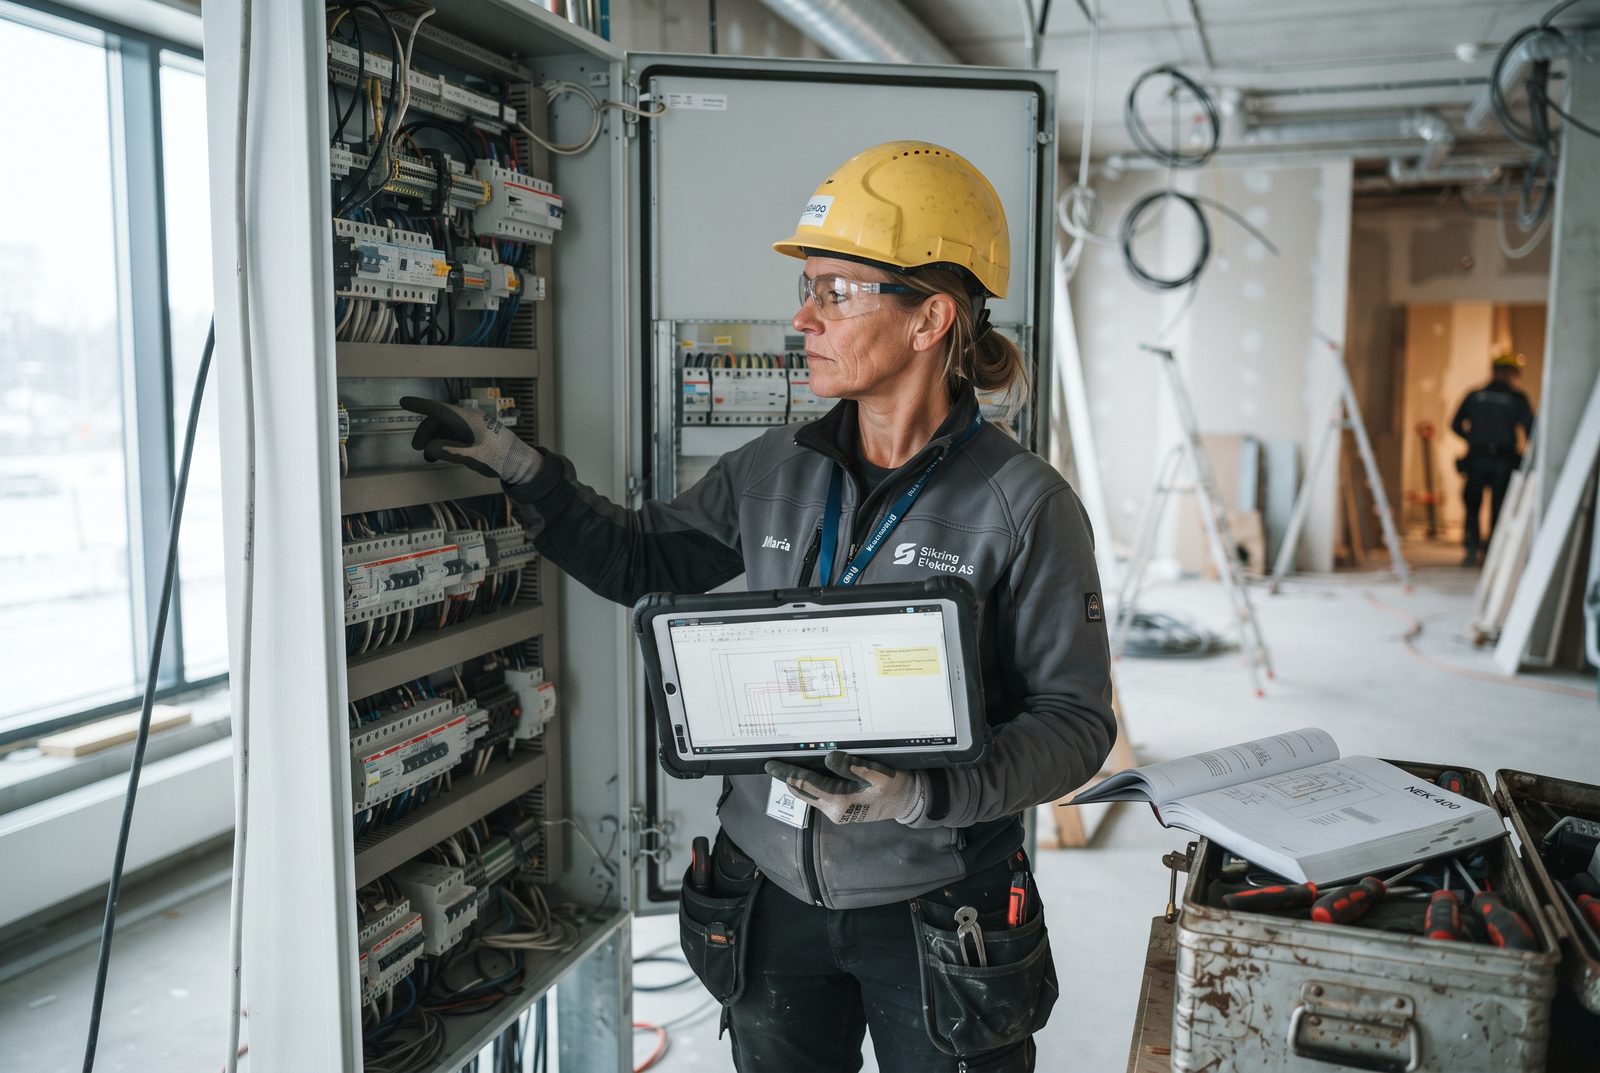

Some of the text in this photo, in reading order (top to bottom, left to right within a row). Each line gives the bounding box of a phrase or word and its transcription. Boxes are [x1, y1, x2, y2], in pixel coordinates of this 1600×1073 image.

[761, 535, 791, 551] Maria
[920, 546, 959, 564] Sikring
[917, 557, 975, 575] Elektro AS
[1404, 786, 1461, 810] NEK 400
